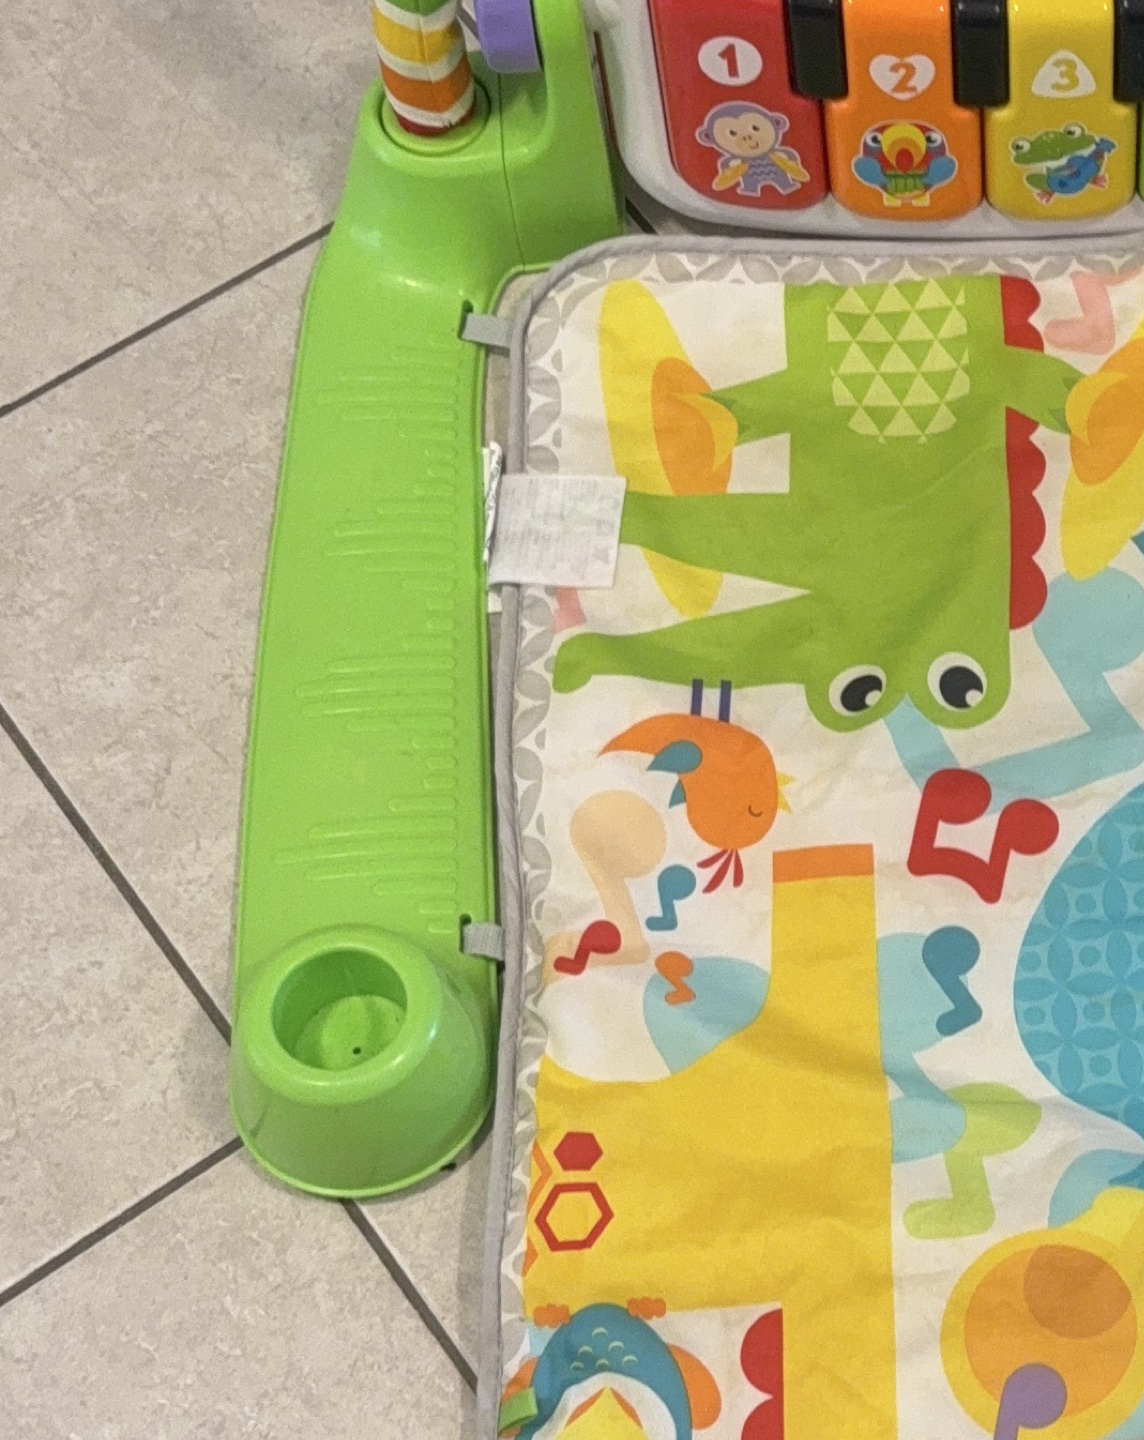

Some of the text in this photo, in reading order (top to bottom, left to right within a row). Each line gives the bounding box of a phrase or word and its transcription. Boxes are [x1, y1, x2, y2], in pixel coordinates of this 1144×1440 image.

[718, 42, 740, 79] 1
[889, 61, 918, 94] 2
[1050, 58, 1080, 93] 3
